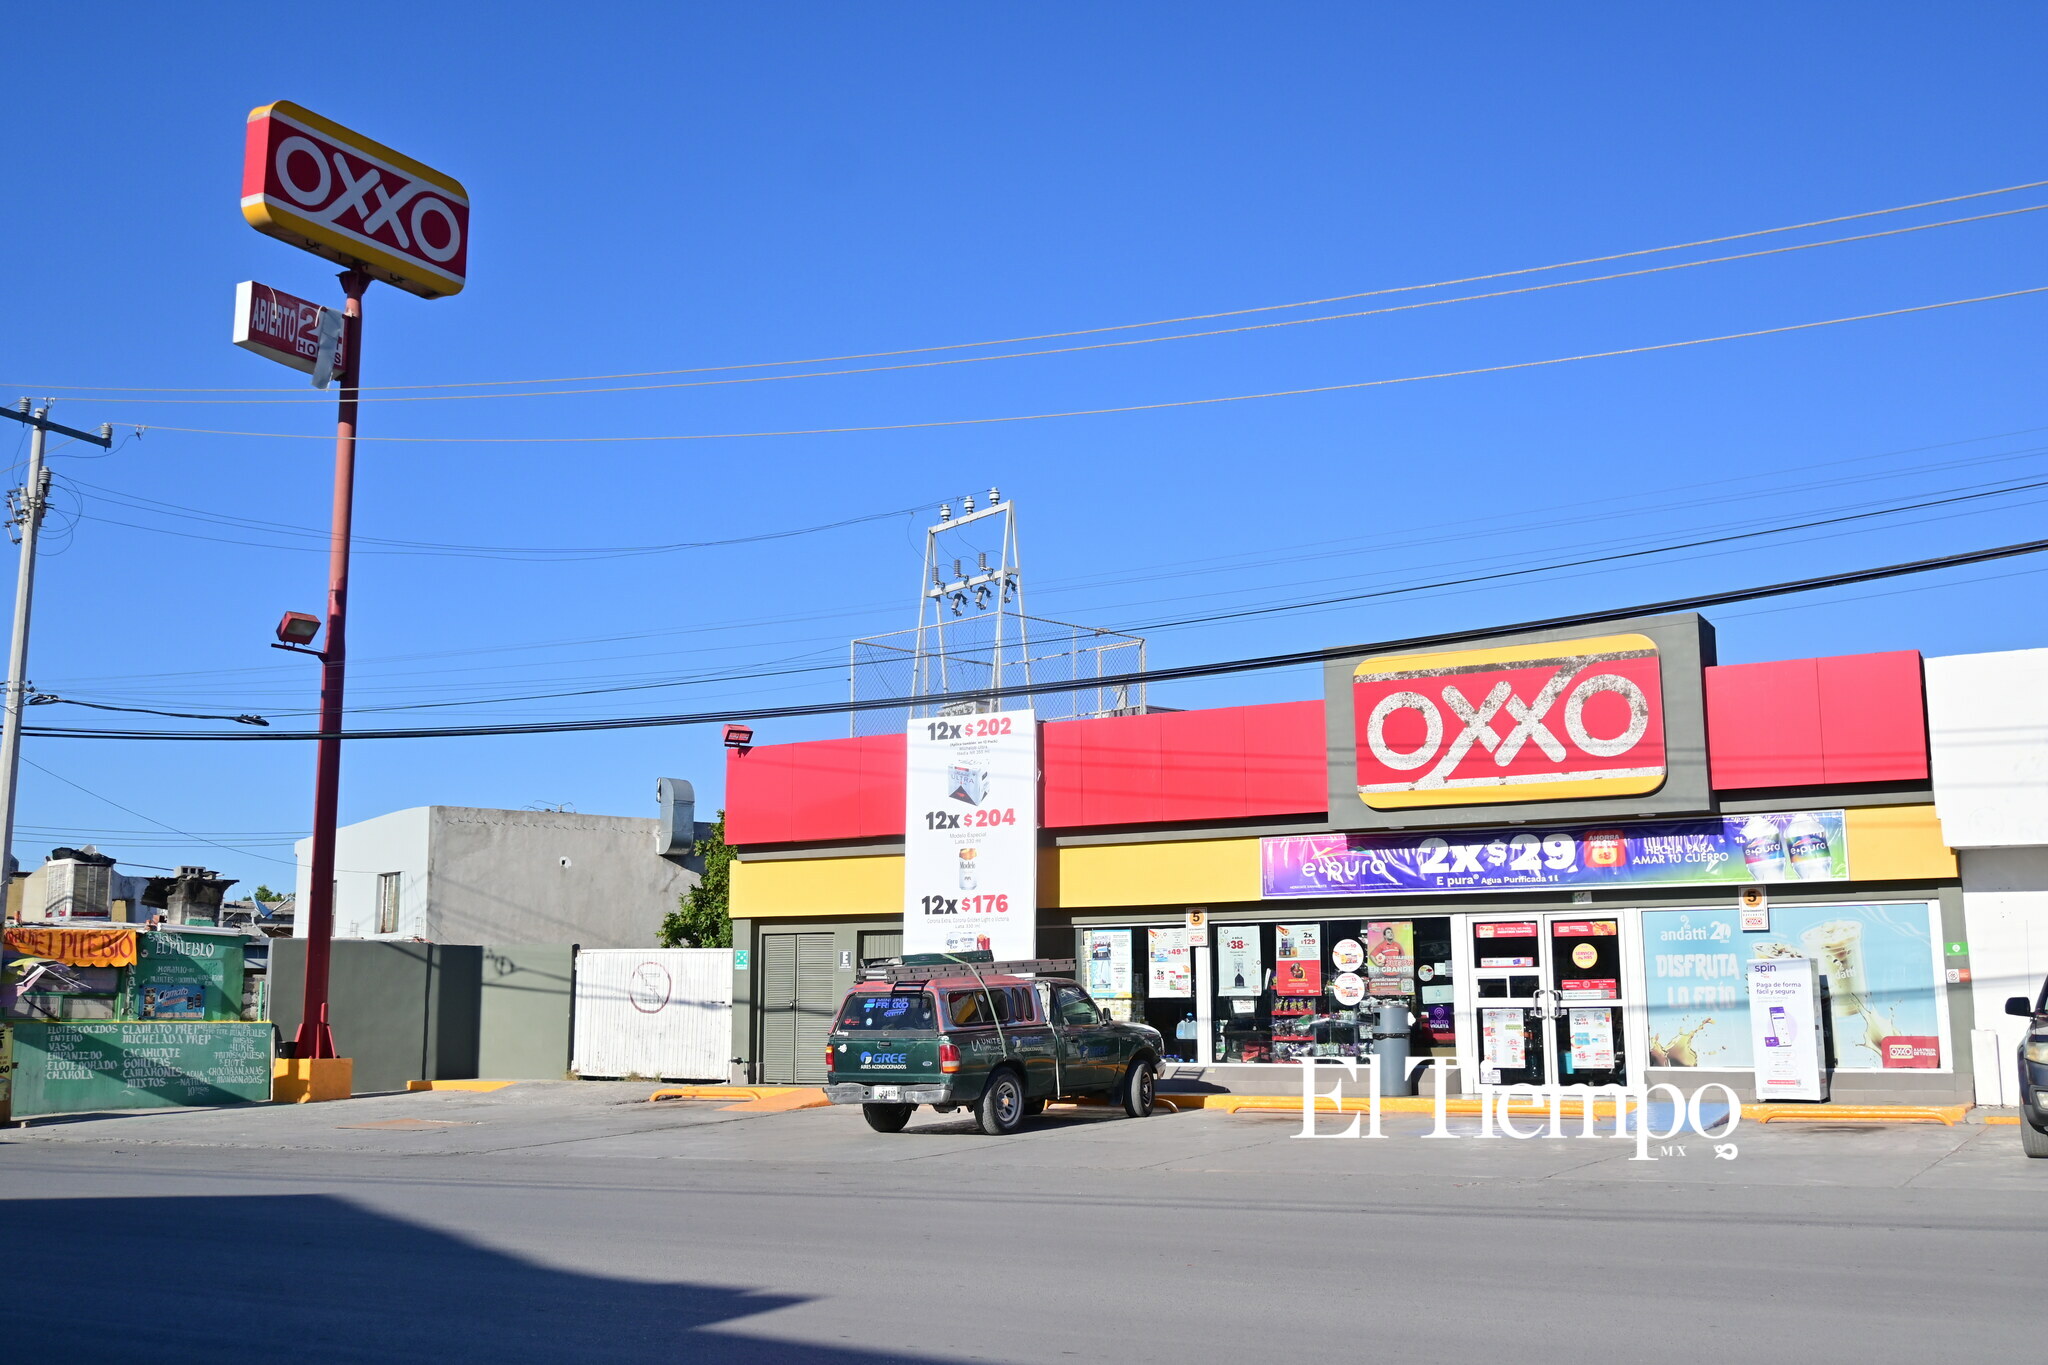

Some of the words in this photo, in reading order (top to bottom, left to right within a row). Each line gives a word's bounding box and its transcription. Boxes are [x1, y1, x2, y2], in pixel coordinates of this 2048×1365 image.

[275, 135, 461, 262] OXXO
[252, 297, 296, 343] ABIERTO
[297, 340, 341, 364] HOS
[1366, 668, 1649, 778] OXXO
[928, 721, 962, 741] 12x
[965, 717, 1012, 737] $202
[951, 774, 974, 784] ULTRA
[926, 811, 960, 830] 12x
[963, 808, 1016, 827] $204
[1588, 834, 1620, 842] AHORRA
[1687, 844, 1715, 854] PARA
[1632, 855, 1665, 865] AMAR
[1684, 852, 1729, 864] CUERPO
[1481, 877, 1502, 885] Agua
[1503, 875, 1547, 884] Purificada
[1747, 891, 1757, 903] 5
[922, 895, 958, 915] 12x
[961, 894, 1008, 913] $176
[1193, 911, 1200, 922] 5
[156, 942, 168, 954] EL
[170, 942, 215, 957] PUEBLO
[1227, 940, 1243, 949] $38
[1656, 954, 1740, 980] DISFRUTA
[1754, 963, 1776, 974] spin
[157, 987, 189, 1002] Clamato
[1668, 986, 1689, 1008] LO
[1694, 981, 1736, 1009] FRÍO
[48, 1026, 77, 1034] ELOTES
[78, 1025, 118, 1033] COCIDOS
[122, 1024, 172, 1034] CLAMATO
[50, 1034, 83, 1042] ENTERO
[122, 1034, 183, 1044] MICHELADA
[186, 1034, 211, 1045] PREP
[48, 1043, 74, 1051] VASO
[1890, 1047, 1912, 1057] OXXO
[123, 1058, 171, 1068] GOMITAS
[872, 1053, 907, 1063] GREE
[46, 1070, 93, 1079] CHAROLA
[127, 1078, 166, 1088] MIXTOS
